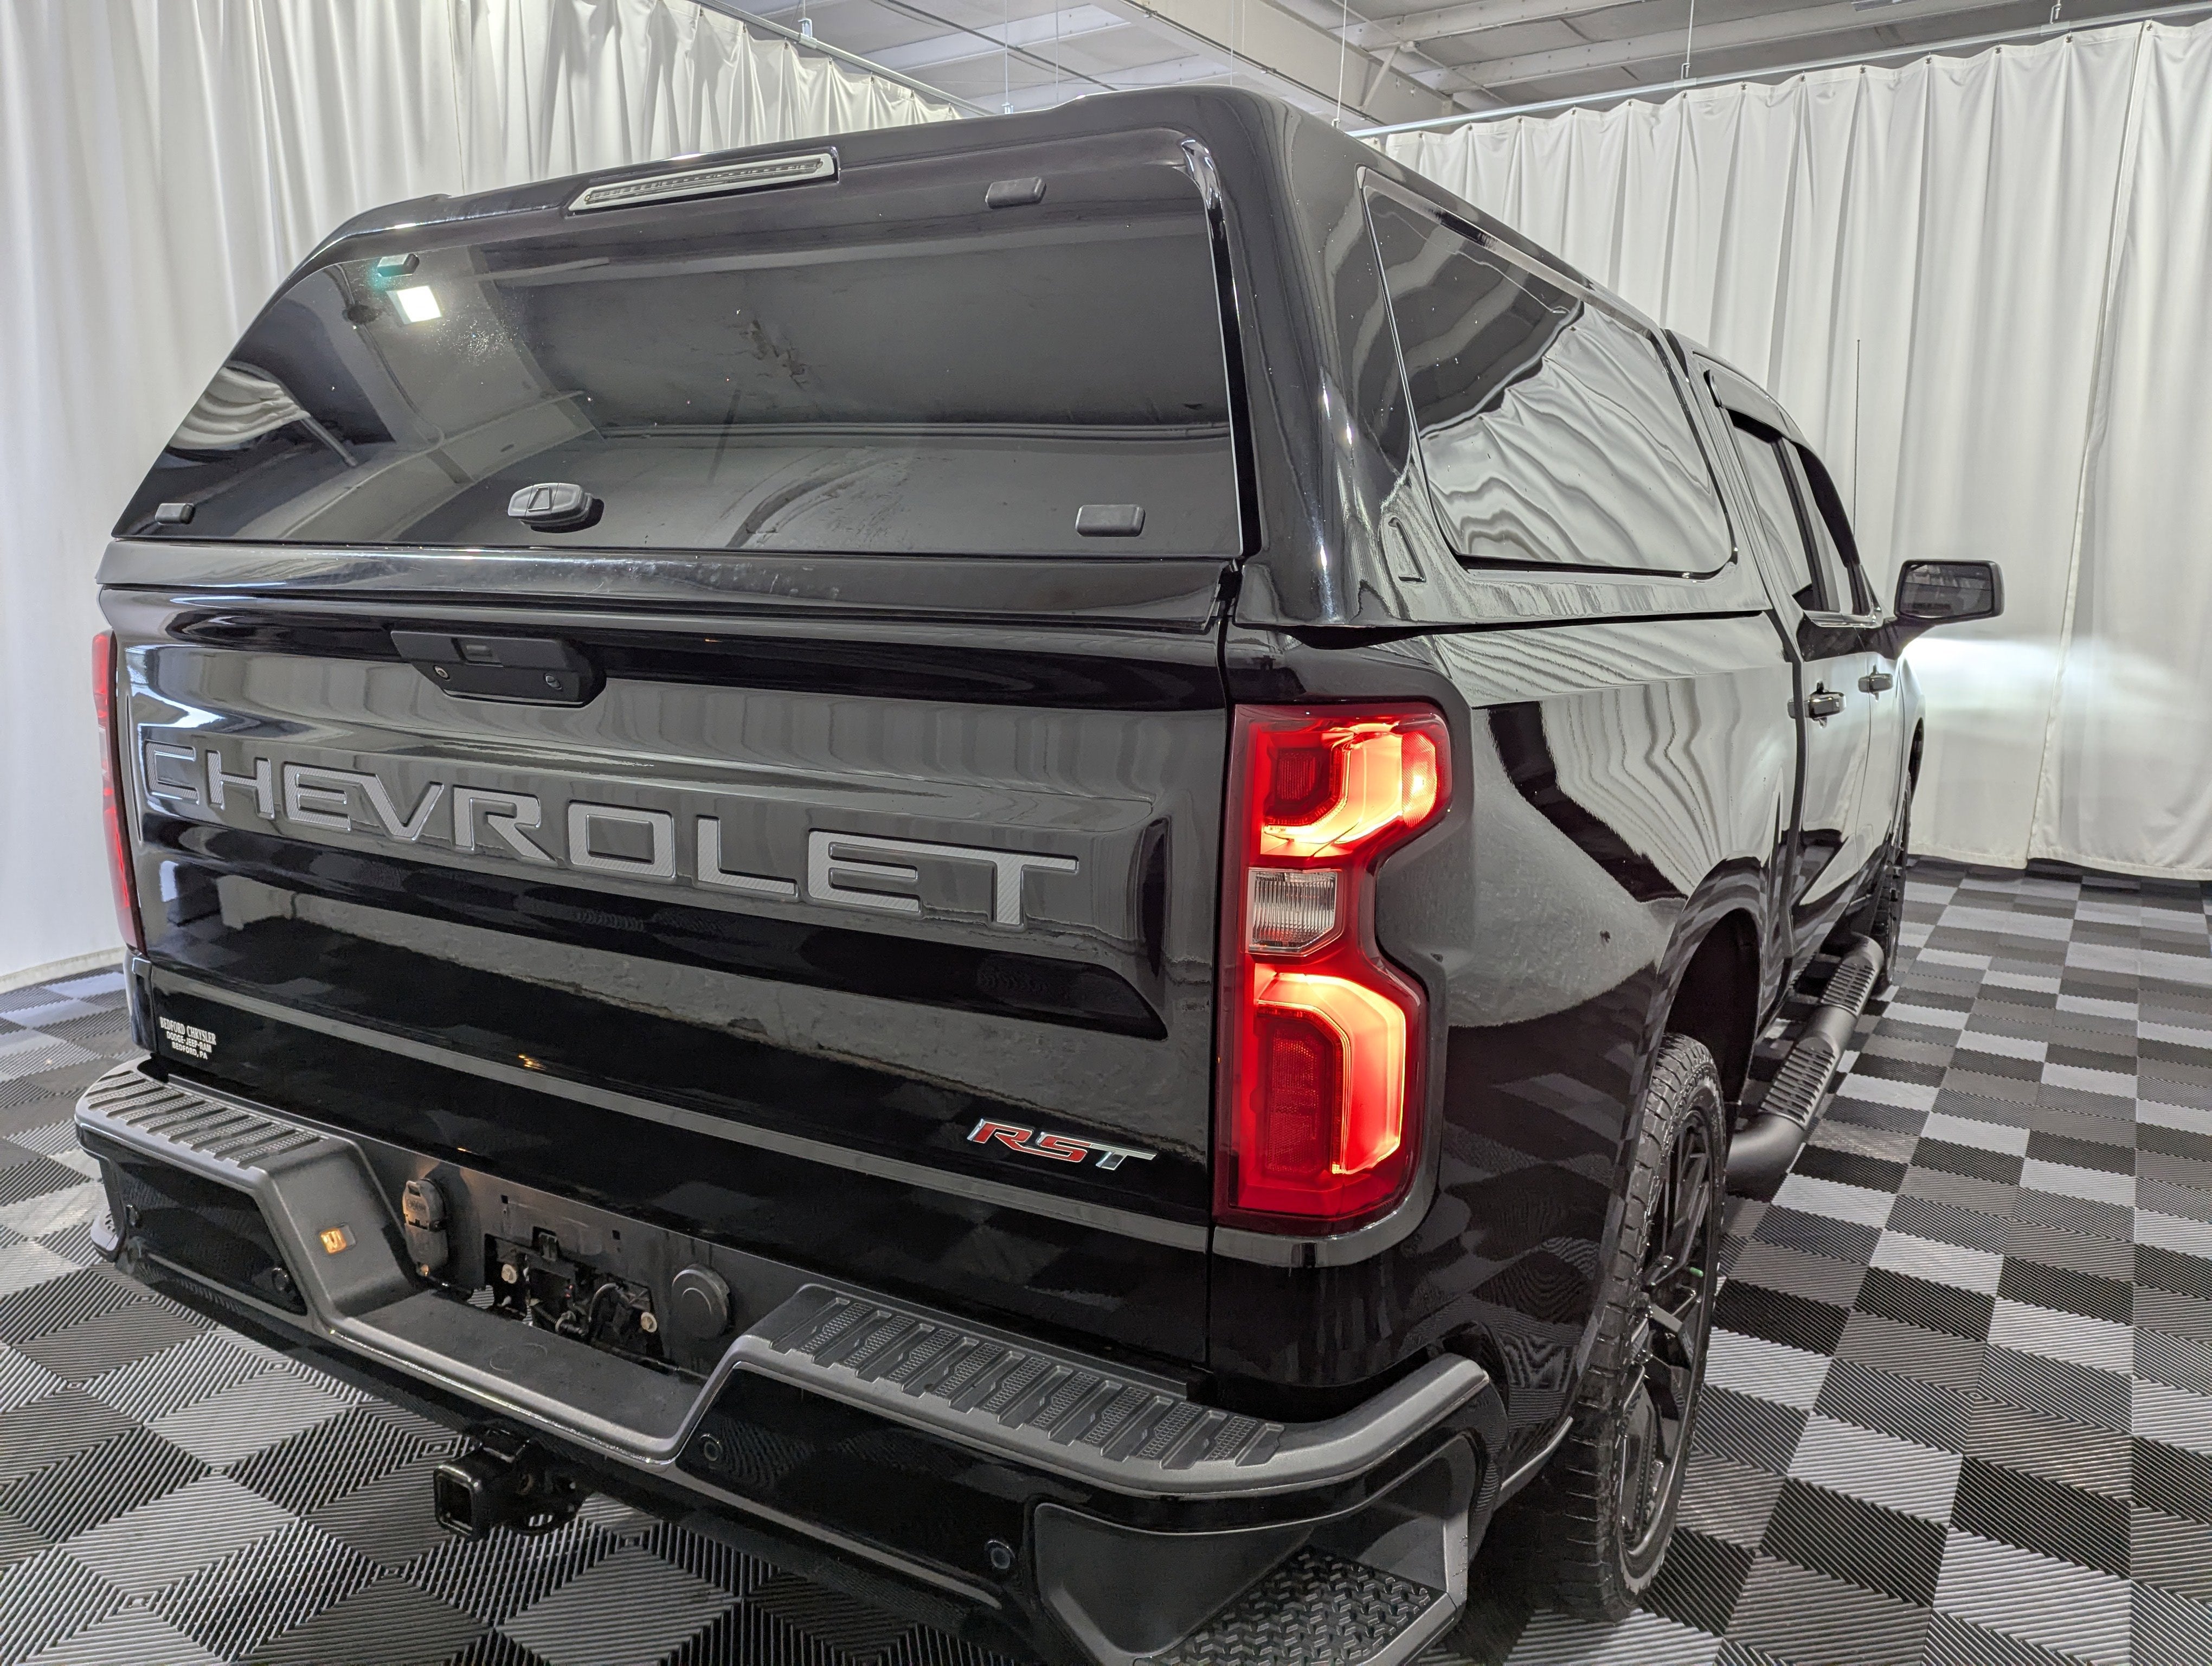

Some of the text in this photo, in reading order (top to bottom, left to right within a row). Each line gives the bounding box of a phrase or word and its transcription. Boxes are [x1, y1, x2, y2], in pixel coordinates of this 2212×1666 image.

[145, 739, 1079, 926] CHEVROLET
[159, 1016, 217, 1046] BEDFORD CHRYSLER
[171, 1041, 208, 1060] BEDFORD, PA
[967, 1118, 1158, 1171] RST
